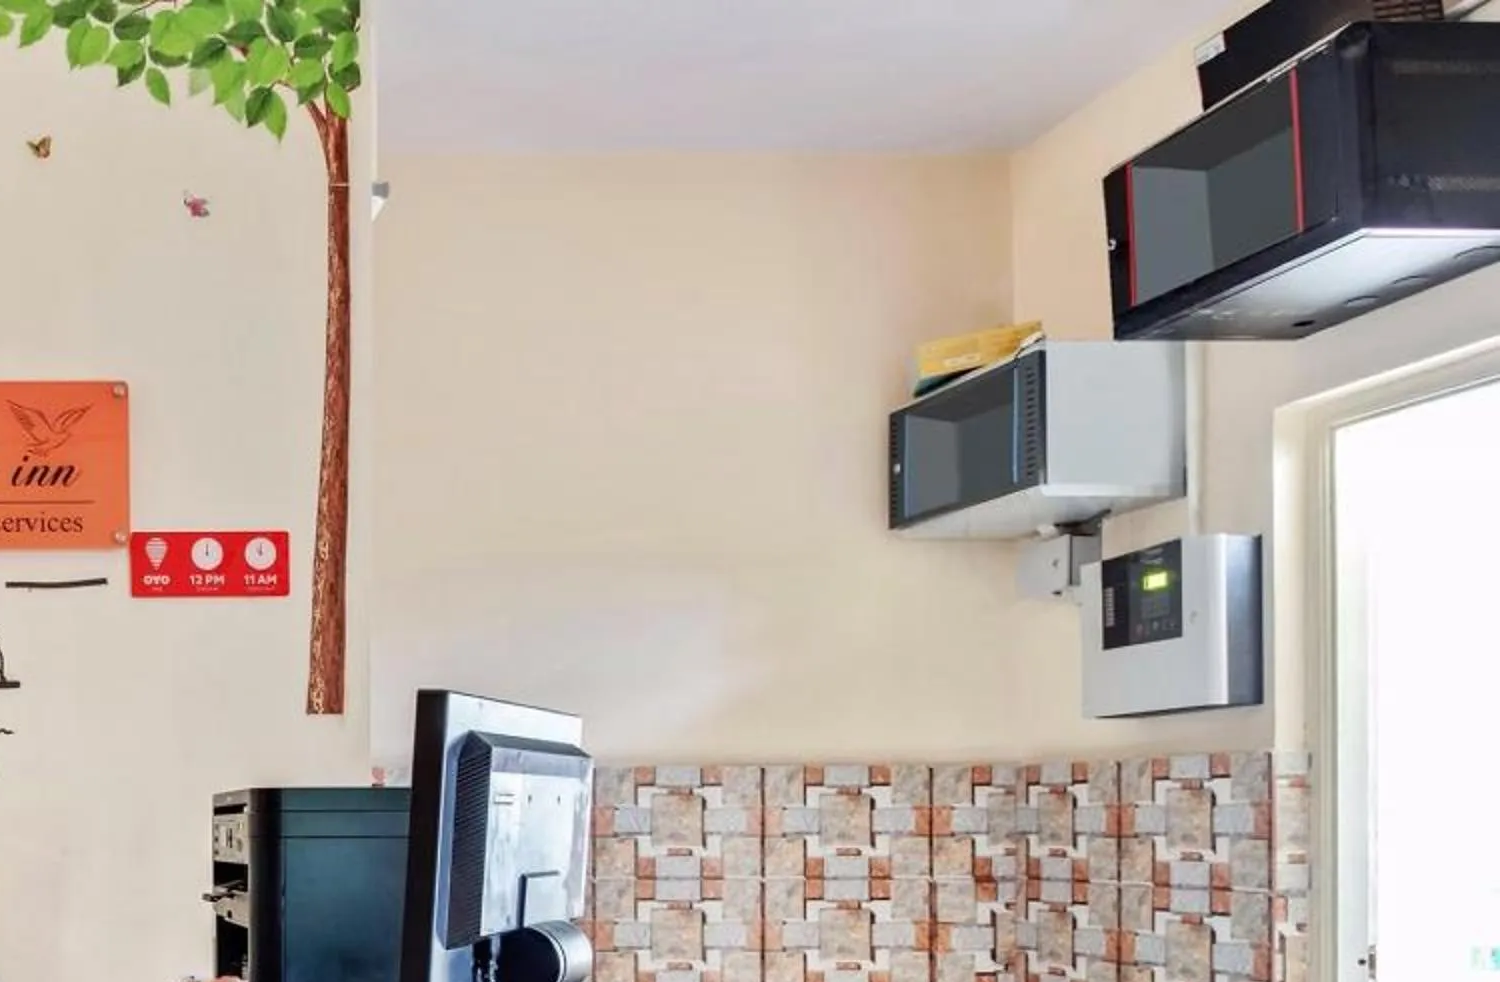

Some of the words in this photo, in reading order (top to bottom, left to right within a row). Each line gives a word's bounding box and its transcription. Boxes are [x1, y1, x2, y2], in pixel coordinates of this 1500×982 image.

[10, 454, 84, 488] inn
[142, 574, 171, 586] OYO
[189, 574, 203, 586] 12
[204, 574, 226, 586] PM
[243, 574, 256, 586] 11
[256, 574, 278, 586] AM
